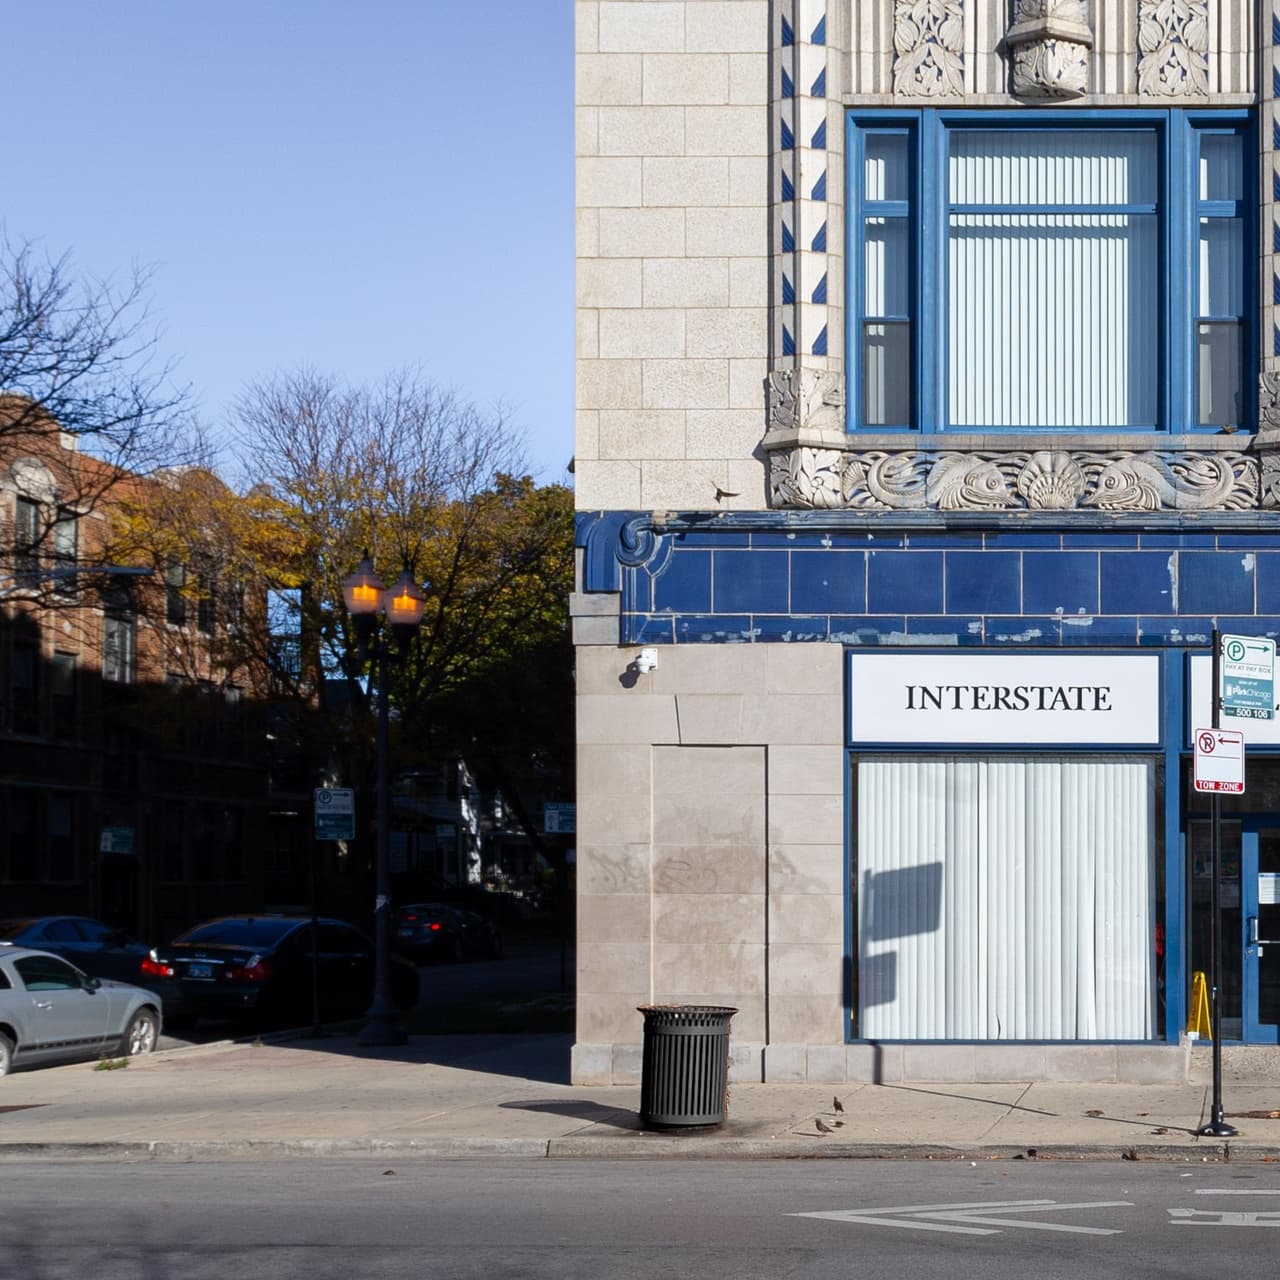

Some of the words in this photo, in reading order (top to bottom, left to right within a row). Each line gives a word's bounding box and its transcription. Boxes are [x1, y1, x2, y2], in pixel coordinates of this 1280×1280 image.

[905, 686, 1113, 711] INTERSTATE
[1236, 708, 1251, 717] 500
[1199, 781, 1215, 791] TOW
[1219, 782, 1241, 792] ZONE
